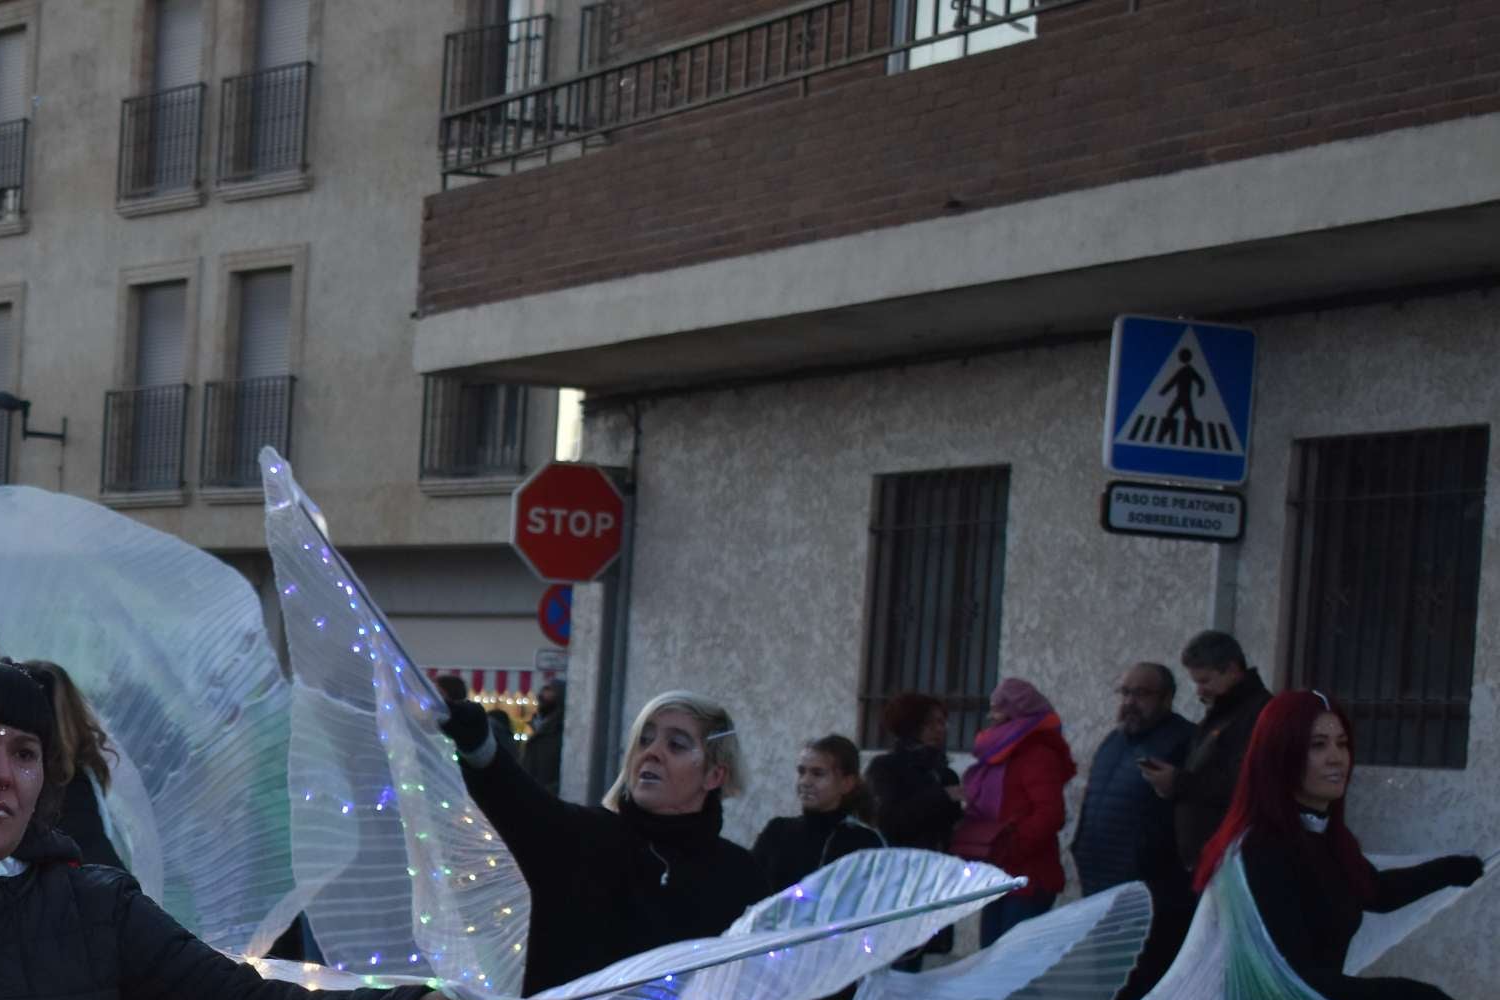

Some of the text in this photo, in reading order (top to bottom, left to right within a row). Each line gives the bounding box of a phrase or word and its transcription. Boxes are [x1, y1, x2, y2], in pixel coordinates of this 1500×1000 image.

[1115, 492, 1235, 514] PASO DE PEATONES
[527, 506, 615, 538] STOP
